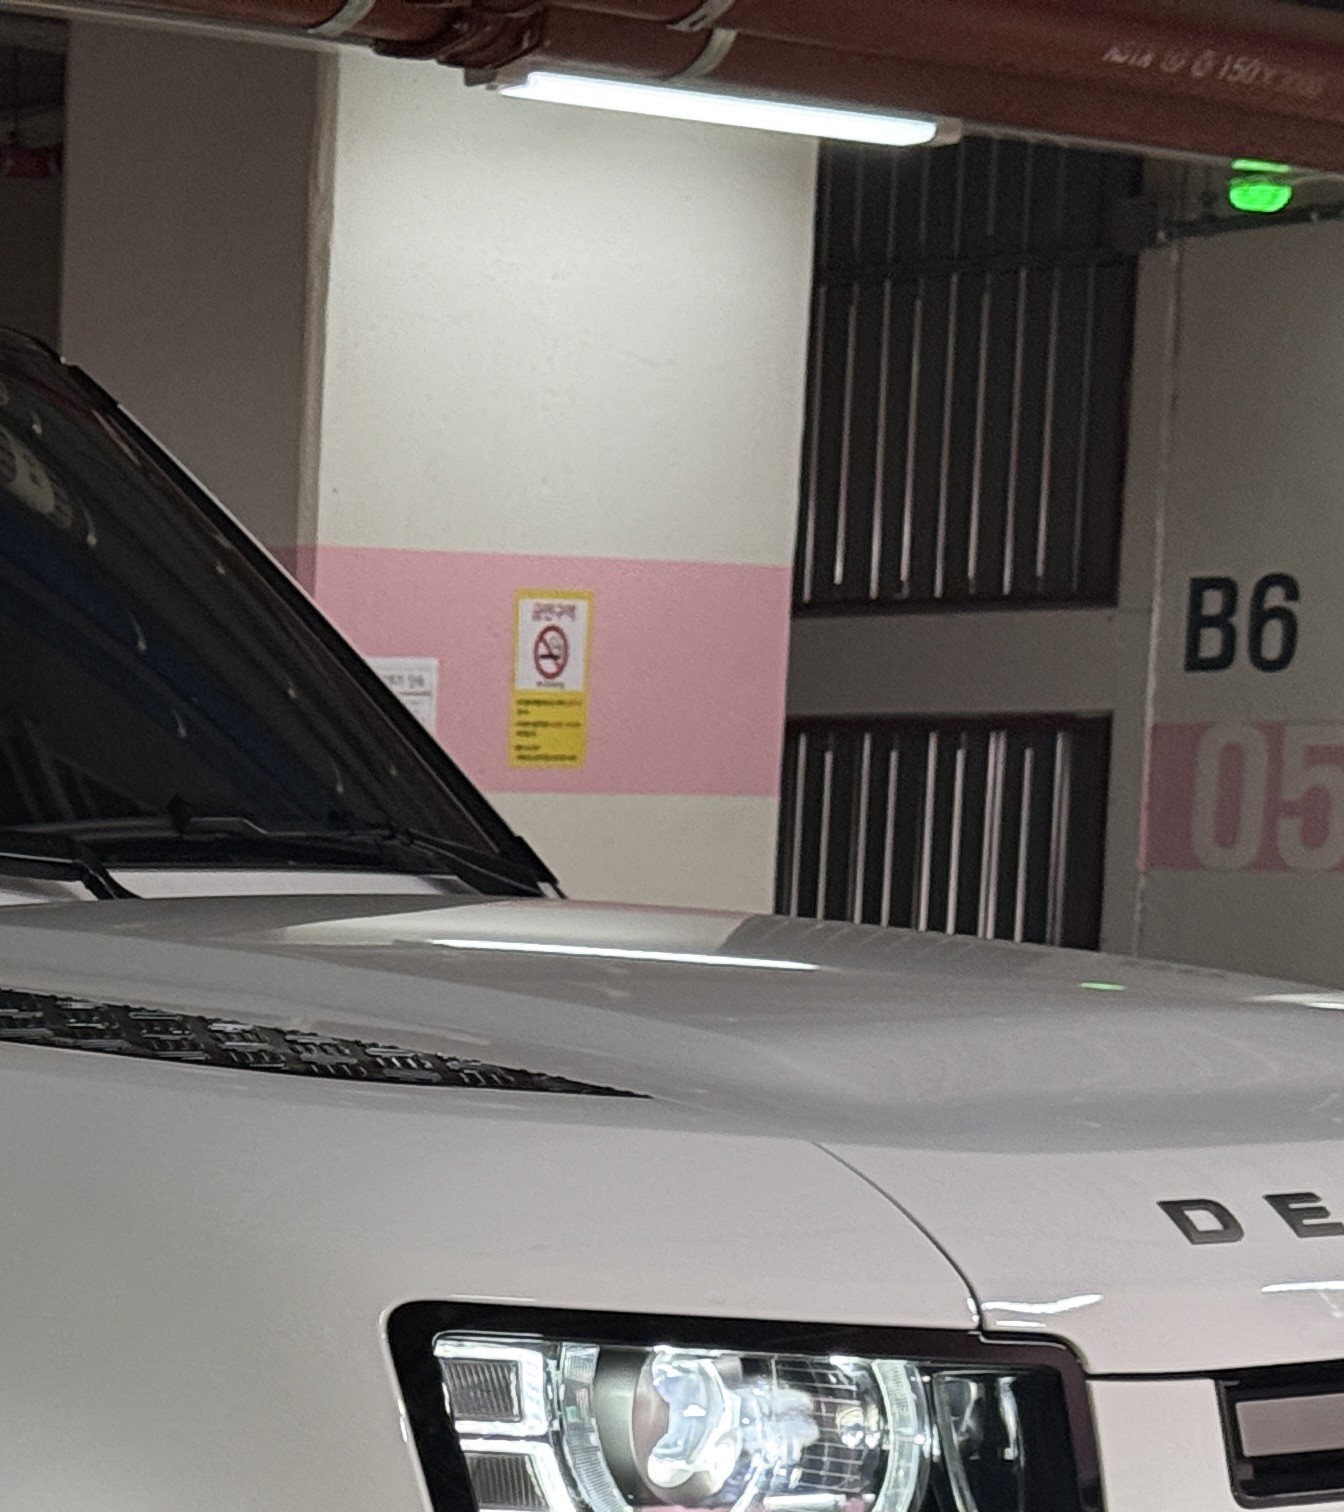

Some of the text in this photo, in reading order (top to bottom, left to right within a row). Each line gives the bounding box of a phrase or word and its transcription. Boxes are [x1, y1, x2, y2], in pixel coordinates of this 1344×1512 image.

[1184, 572, 1300, 674] B6
[1191, 719, 1344, 871] 05
[1155, 1191, 1344, 1247] DE
